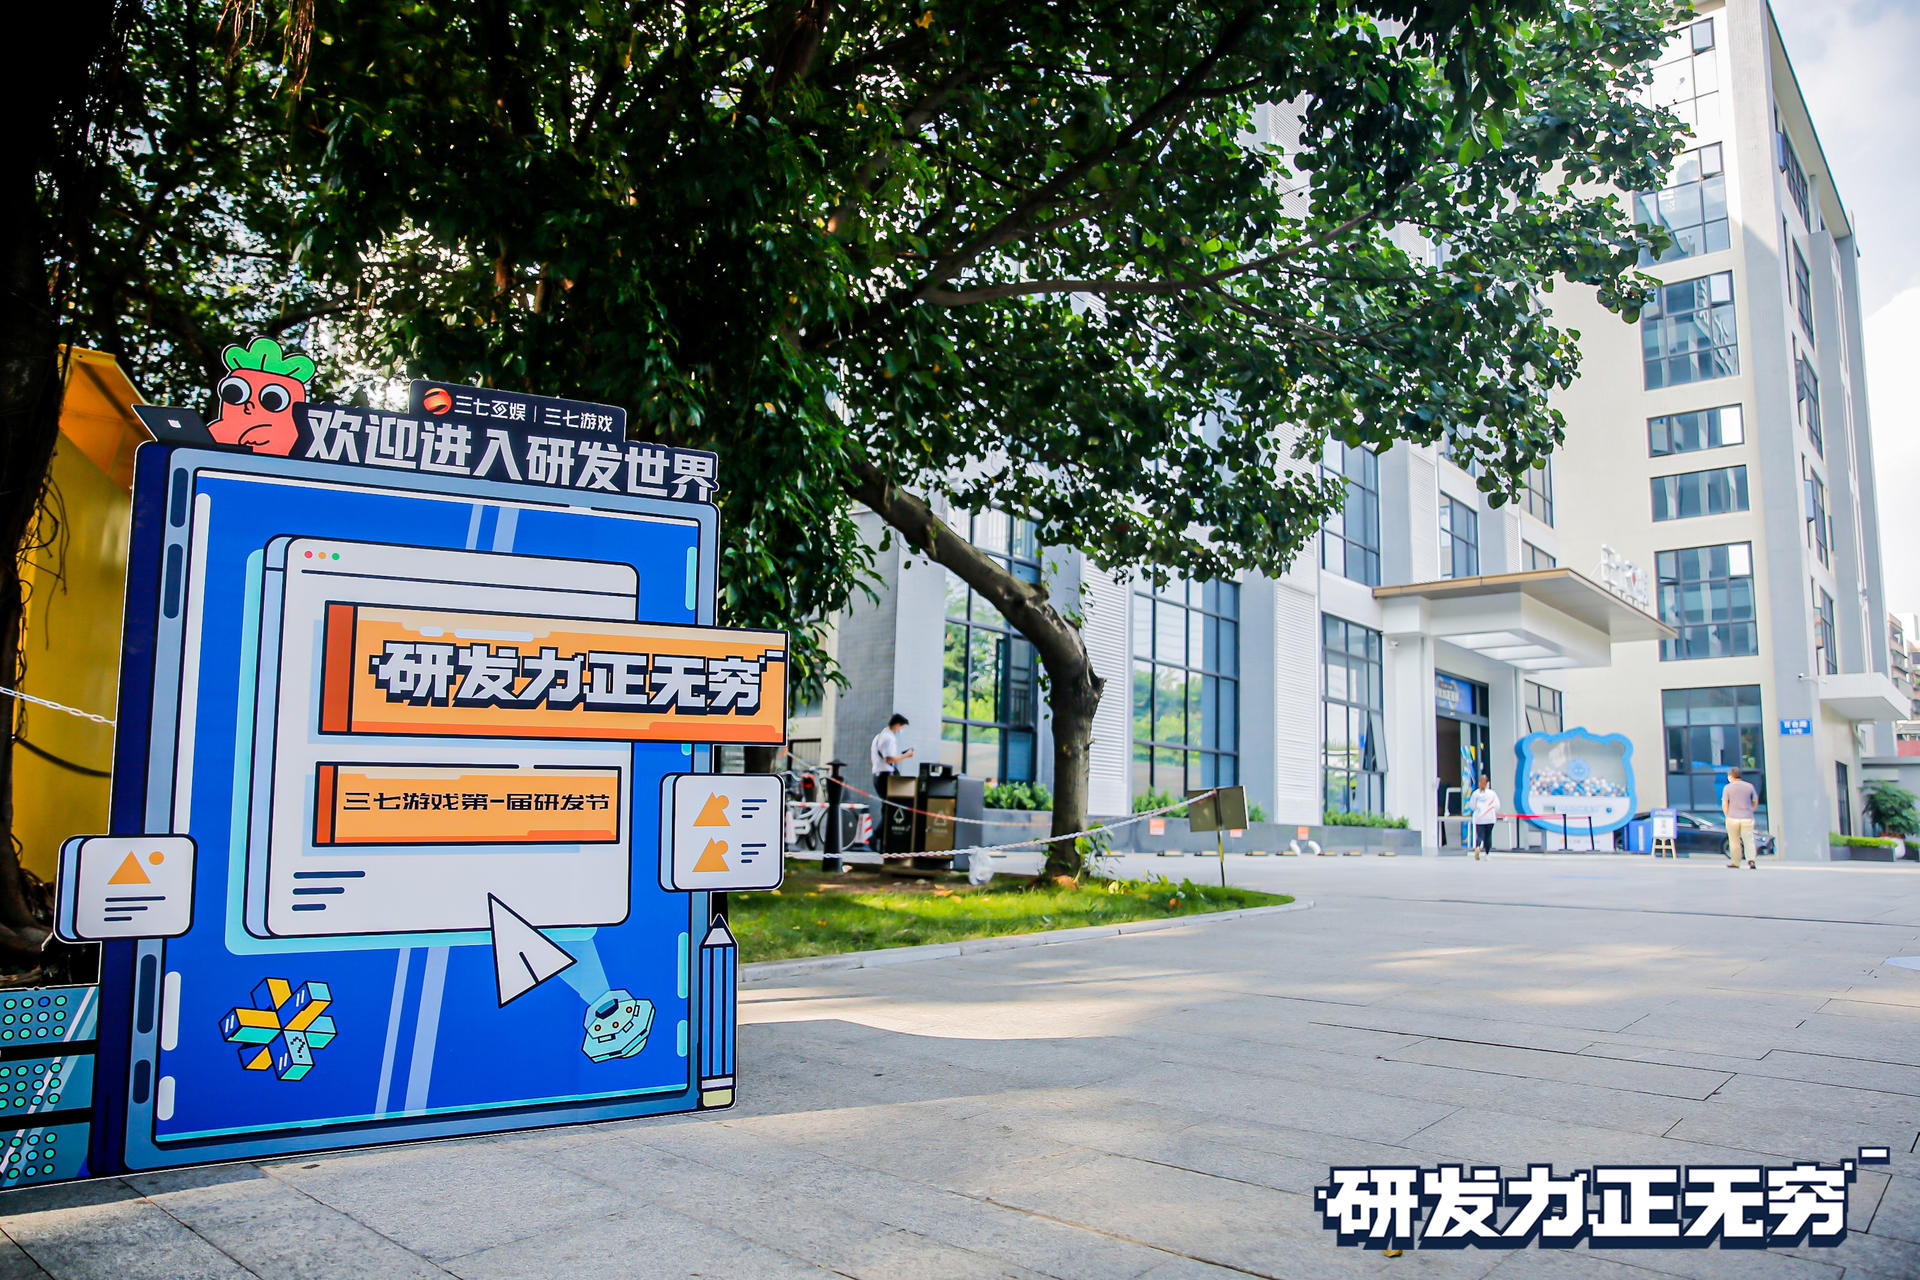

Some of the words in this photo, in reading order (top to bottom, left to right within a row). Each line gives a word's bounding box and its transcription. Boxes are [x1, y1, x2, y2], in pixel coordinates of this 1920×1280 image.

[454, 394, 526, 422] 三七互娱
[543, 407, 613, 433] 三七游戏
[304, 408, 714, 501] 欢迎进入研发世界
[372, 641, 768, 714] 研发力正无穷
[343, 792, 610, 811] 三七游戏第一届研发节
